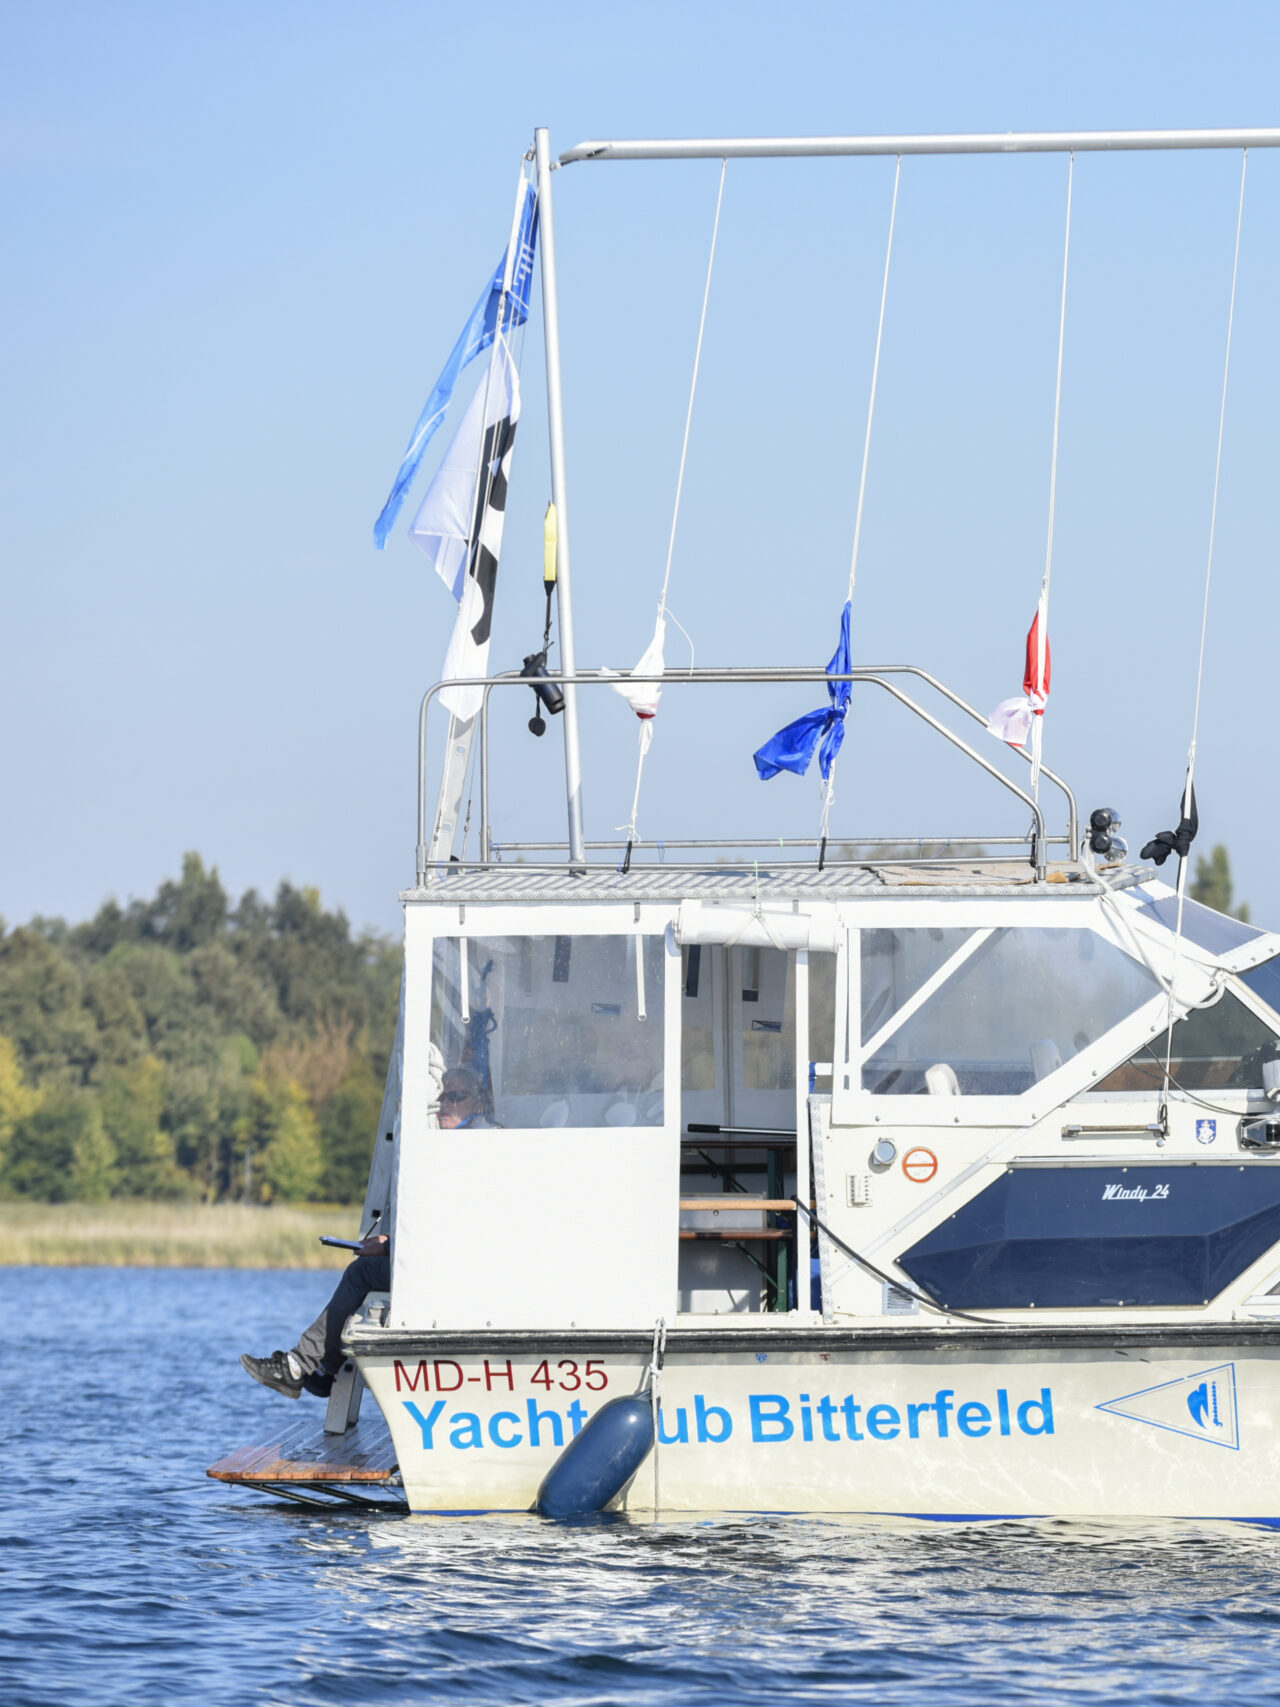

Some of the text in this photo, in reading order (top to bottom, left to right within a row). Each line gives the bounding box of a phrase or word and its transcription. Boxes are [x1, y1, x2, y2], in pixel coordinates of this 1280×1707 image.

[1102, 1184, 1170, 1202] Windy 24
[393, 1360, 608, 1392] MD-H 435
[402, 1387, 1056, 1450] Yachtub Bitterfeld
